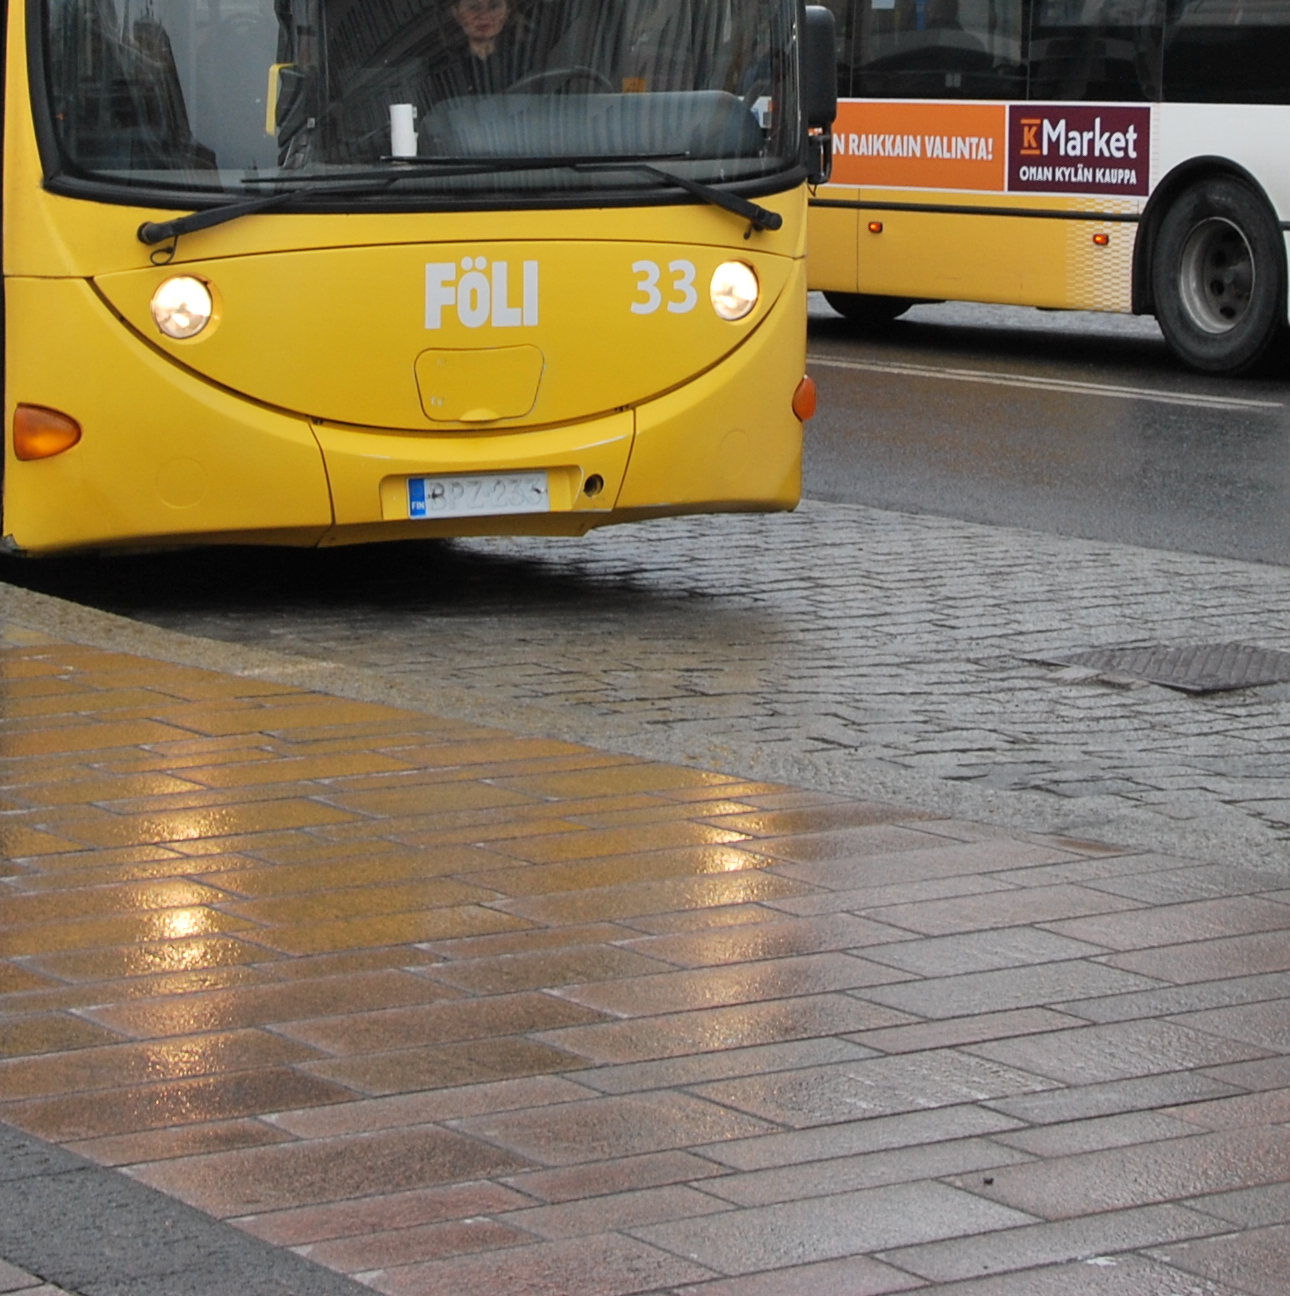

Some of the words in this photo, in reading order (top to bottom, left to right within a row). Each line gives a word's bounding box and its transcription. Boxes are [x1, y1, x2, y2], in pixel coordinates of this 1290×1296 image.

[849, 133, 921, 158] RAIKKAIN
[925, 135, 993, 161] VALINTA!
[1042, 117, 1138, 159] Market
[1019, 166, 1052, 182] OMAN
[1055, 163, 1093, 183] KYLÄN
[1095, 167, 1137, 185] KAUPPA
[425, 255, 539, 329] FÖLI
[630, 259, 698, 315] 33
